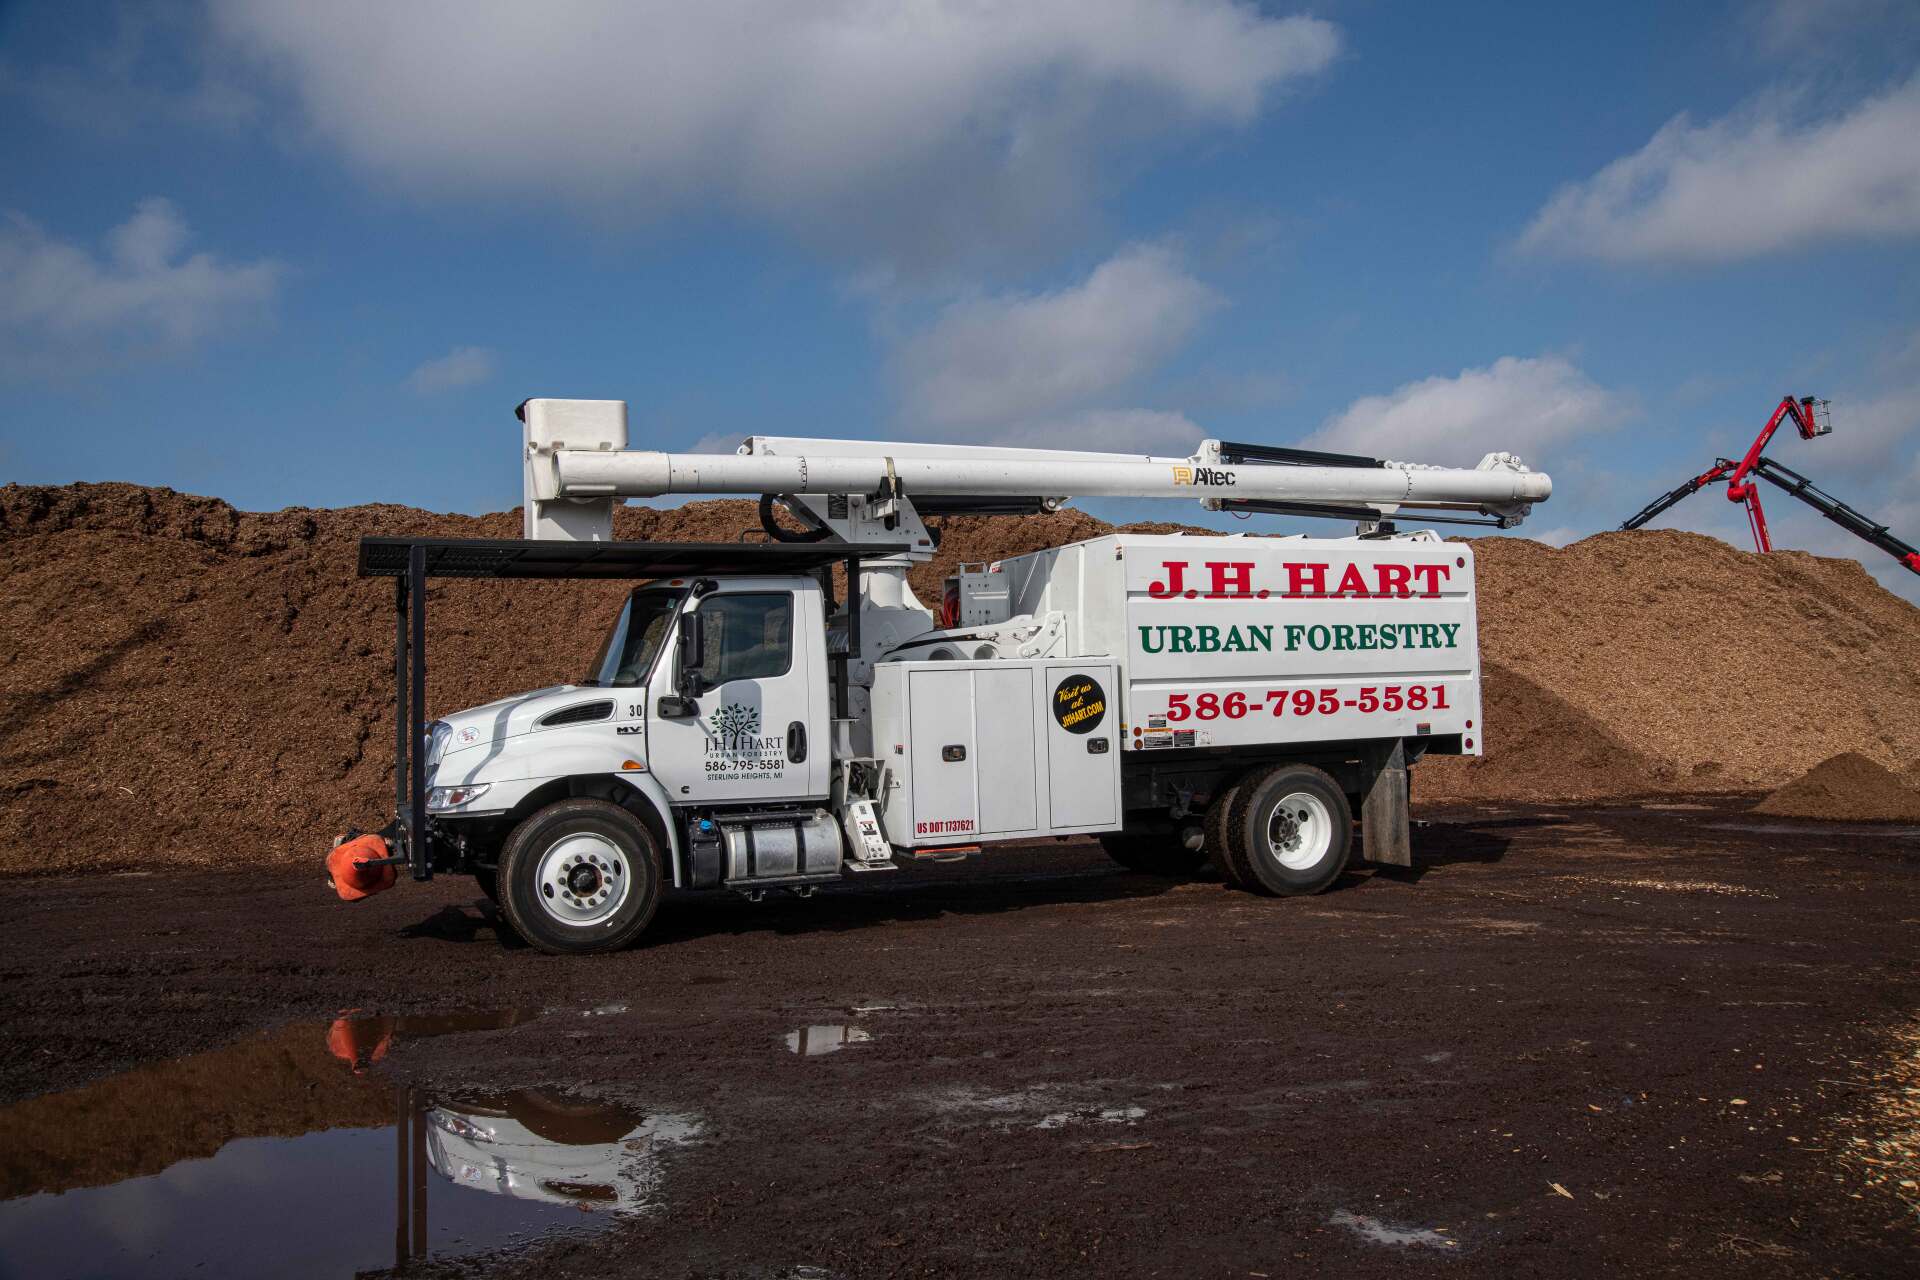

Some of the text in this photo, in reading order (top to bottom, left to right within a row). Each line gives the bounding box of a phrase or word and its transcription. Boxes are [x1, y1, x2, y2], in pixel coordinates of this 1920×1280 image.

[1193, 467, 1236, 486] Altec
[1149, 561, 1450, 599] J.H. HART
[1138, 623, 1461, 653] URBAN FORESTRY
[1057, 683, 1092, 704] Visit us
[629, 704, 642, 717] 30
[1166, 685, 1450, 722] 586-795-5581
[1062, 700, 1105, 728] JHHART.COM
[616, 726, 642, 735] MV
[704, 736, 784, 755] J.H. HART
[742, 750, 783, 758] FORESTRY
[704, 759, 785, 772] 586-795-5581
[707, 773, 740, 781] STERLING
[917, 819, 974, 834] US DOT 1737621
